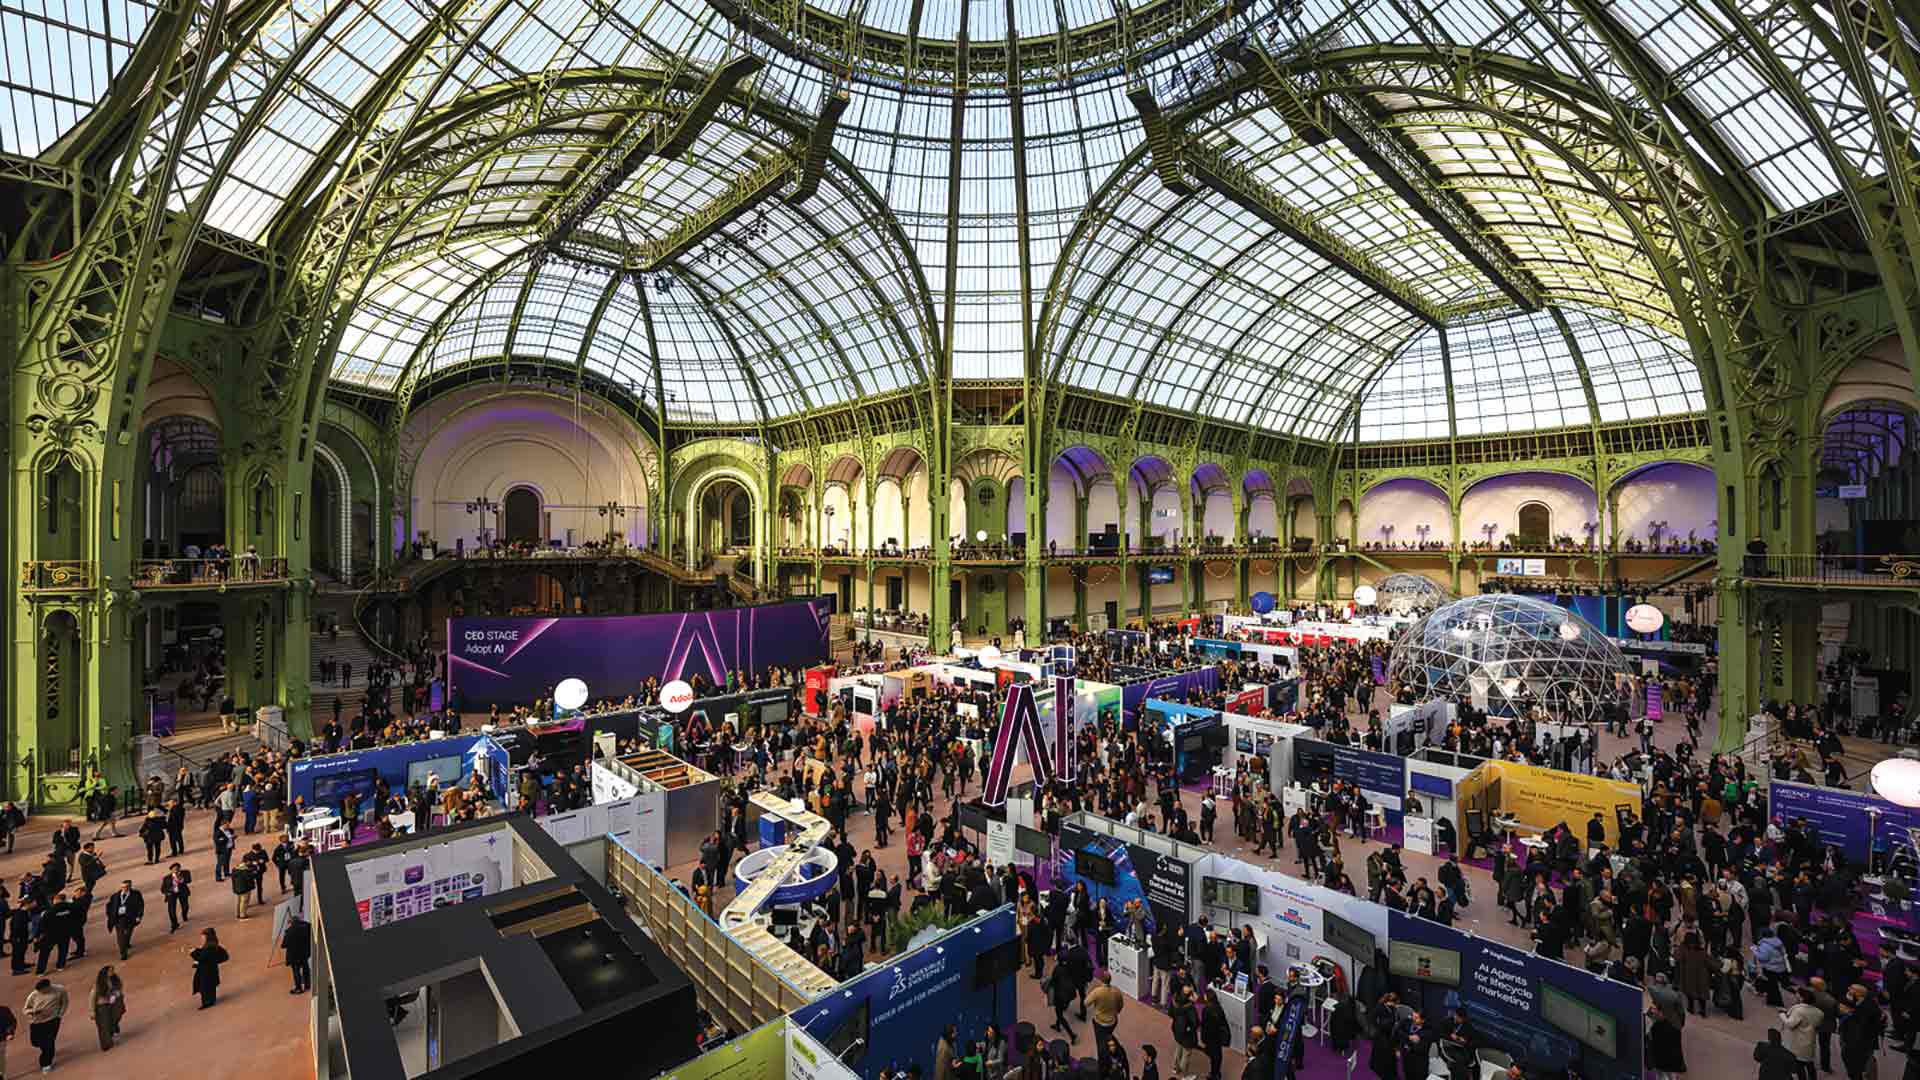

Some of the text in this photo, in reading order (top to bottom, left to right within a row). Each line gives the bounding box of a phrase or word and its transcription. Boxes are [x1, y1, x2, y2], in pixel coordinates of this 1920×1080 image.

[464, 630, 519, 641] CEO STAGE
[465, 643, 505, 655] Adopt AI
[1474, 971, 1534, 1000] for lifecycle
[1479, 963, 1527, 986] AI Agents
[1477, 984, 1530, 1011] marketing
